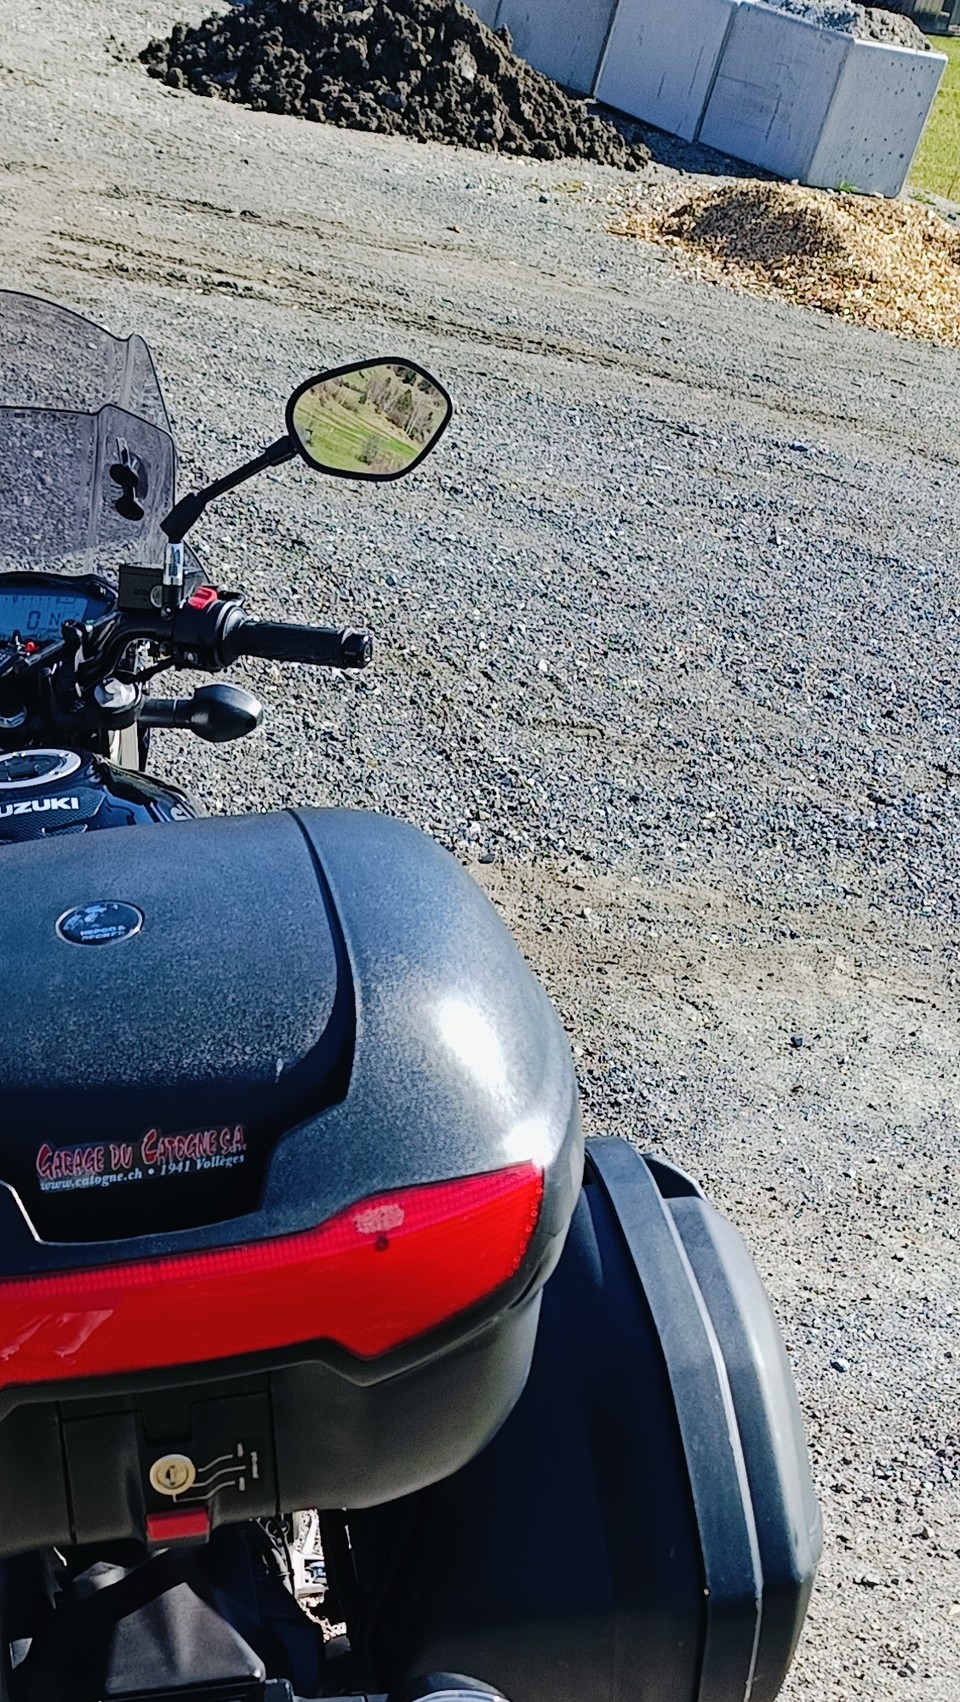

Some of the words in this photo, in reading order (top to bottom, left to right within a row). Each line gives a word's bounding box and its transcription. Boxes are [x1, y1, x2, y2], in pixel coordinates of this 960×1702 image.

[36, 1143, 105, 1180] GARAGE
[110, 1143, 133, 1170] DU
[141, 1129, 218, 1166] CATOGNE
[40, 1168, 143, 1191] www.catogne.ch
[160, 1159, 191, 1177] 1941
[195, 1153, 245, 1170] Vollèges
